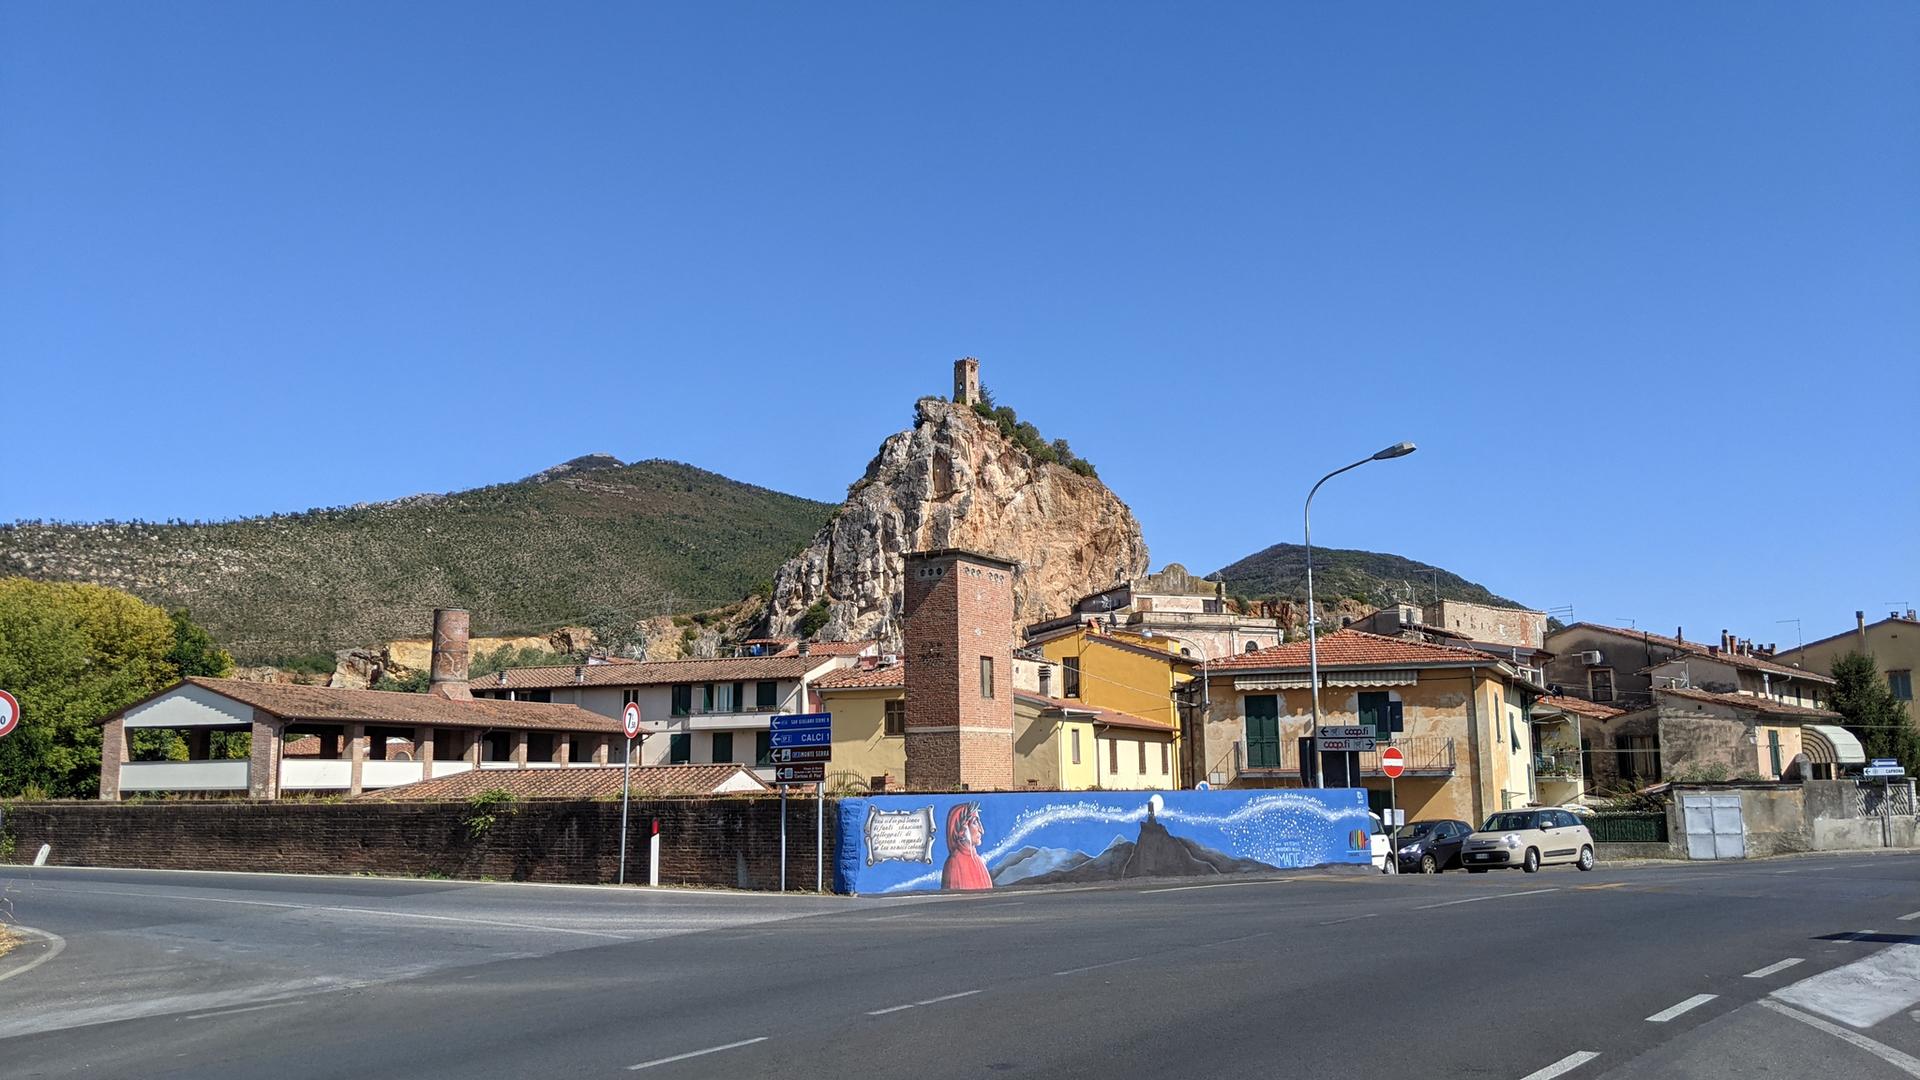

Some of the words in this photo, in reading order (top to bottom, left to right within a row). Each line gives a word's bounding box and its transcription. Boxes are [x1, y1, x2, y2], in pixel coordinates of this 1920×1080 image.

[1344, 727, 1369, 736] coop.fi
[801, 733, 824, 742] CALCI
[1323, 740, 1350, 750] coop.fi
